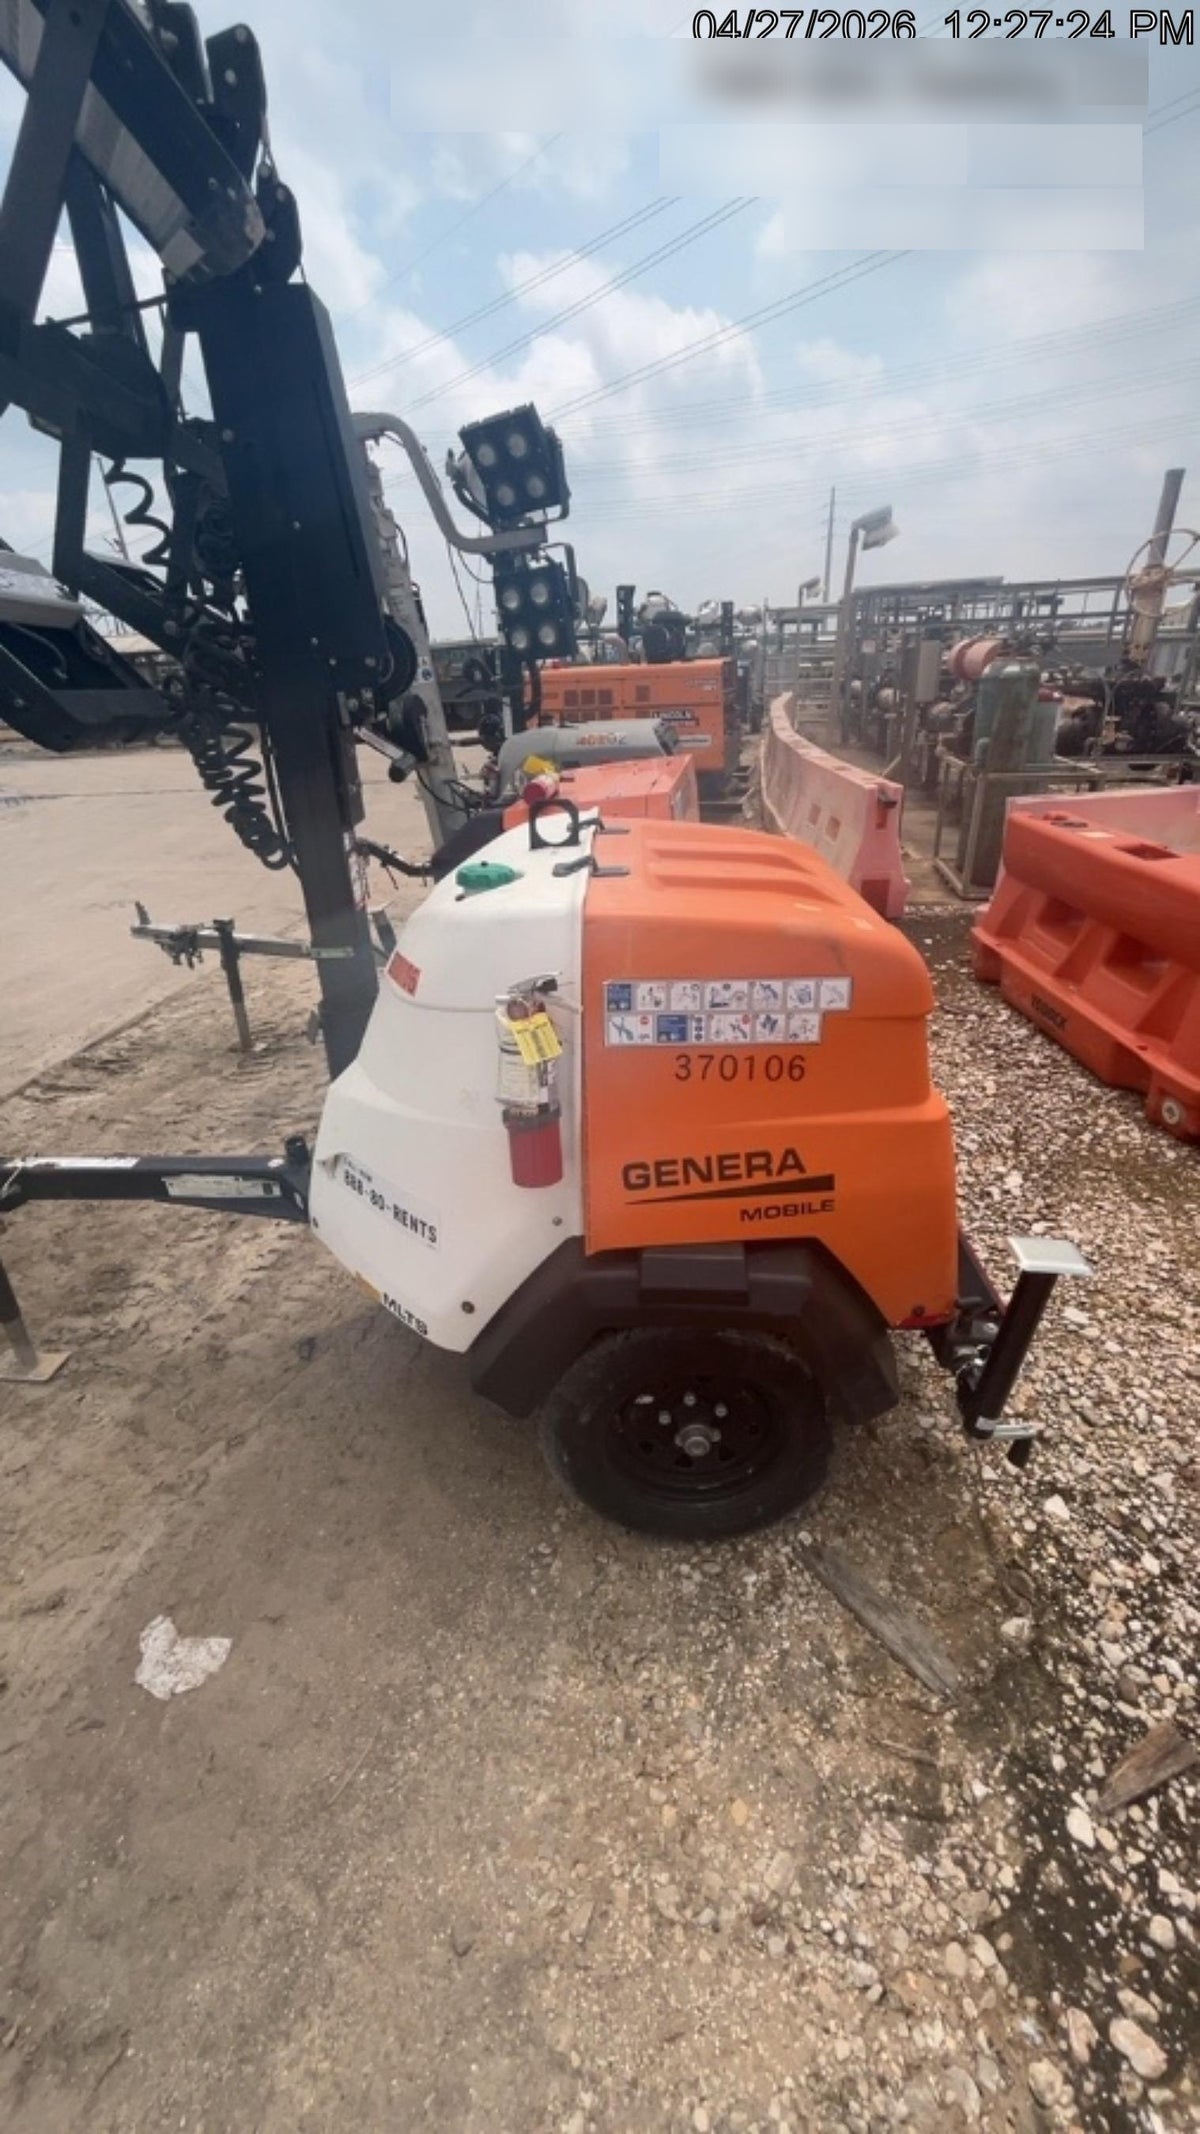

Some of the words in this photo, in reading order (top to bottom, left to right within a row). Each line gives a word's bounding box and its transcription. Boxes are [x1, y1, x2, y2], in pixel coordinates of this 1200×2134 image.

[675, 1054, 806, 1081] 370106
[622, 1147, 807, 1191] GENERA
[739, 1199, 836, 1222] MOBILE
